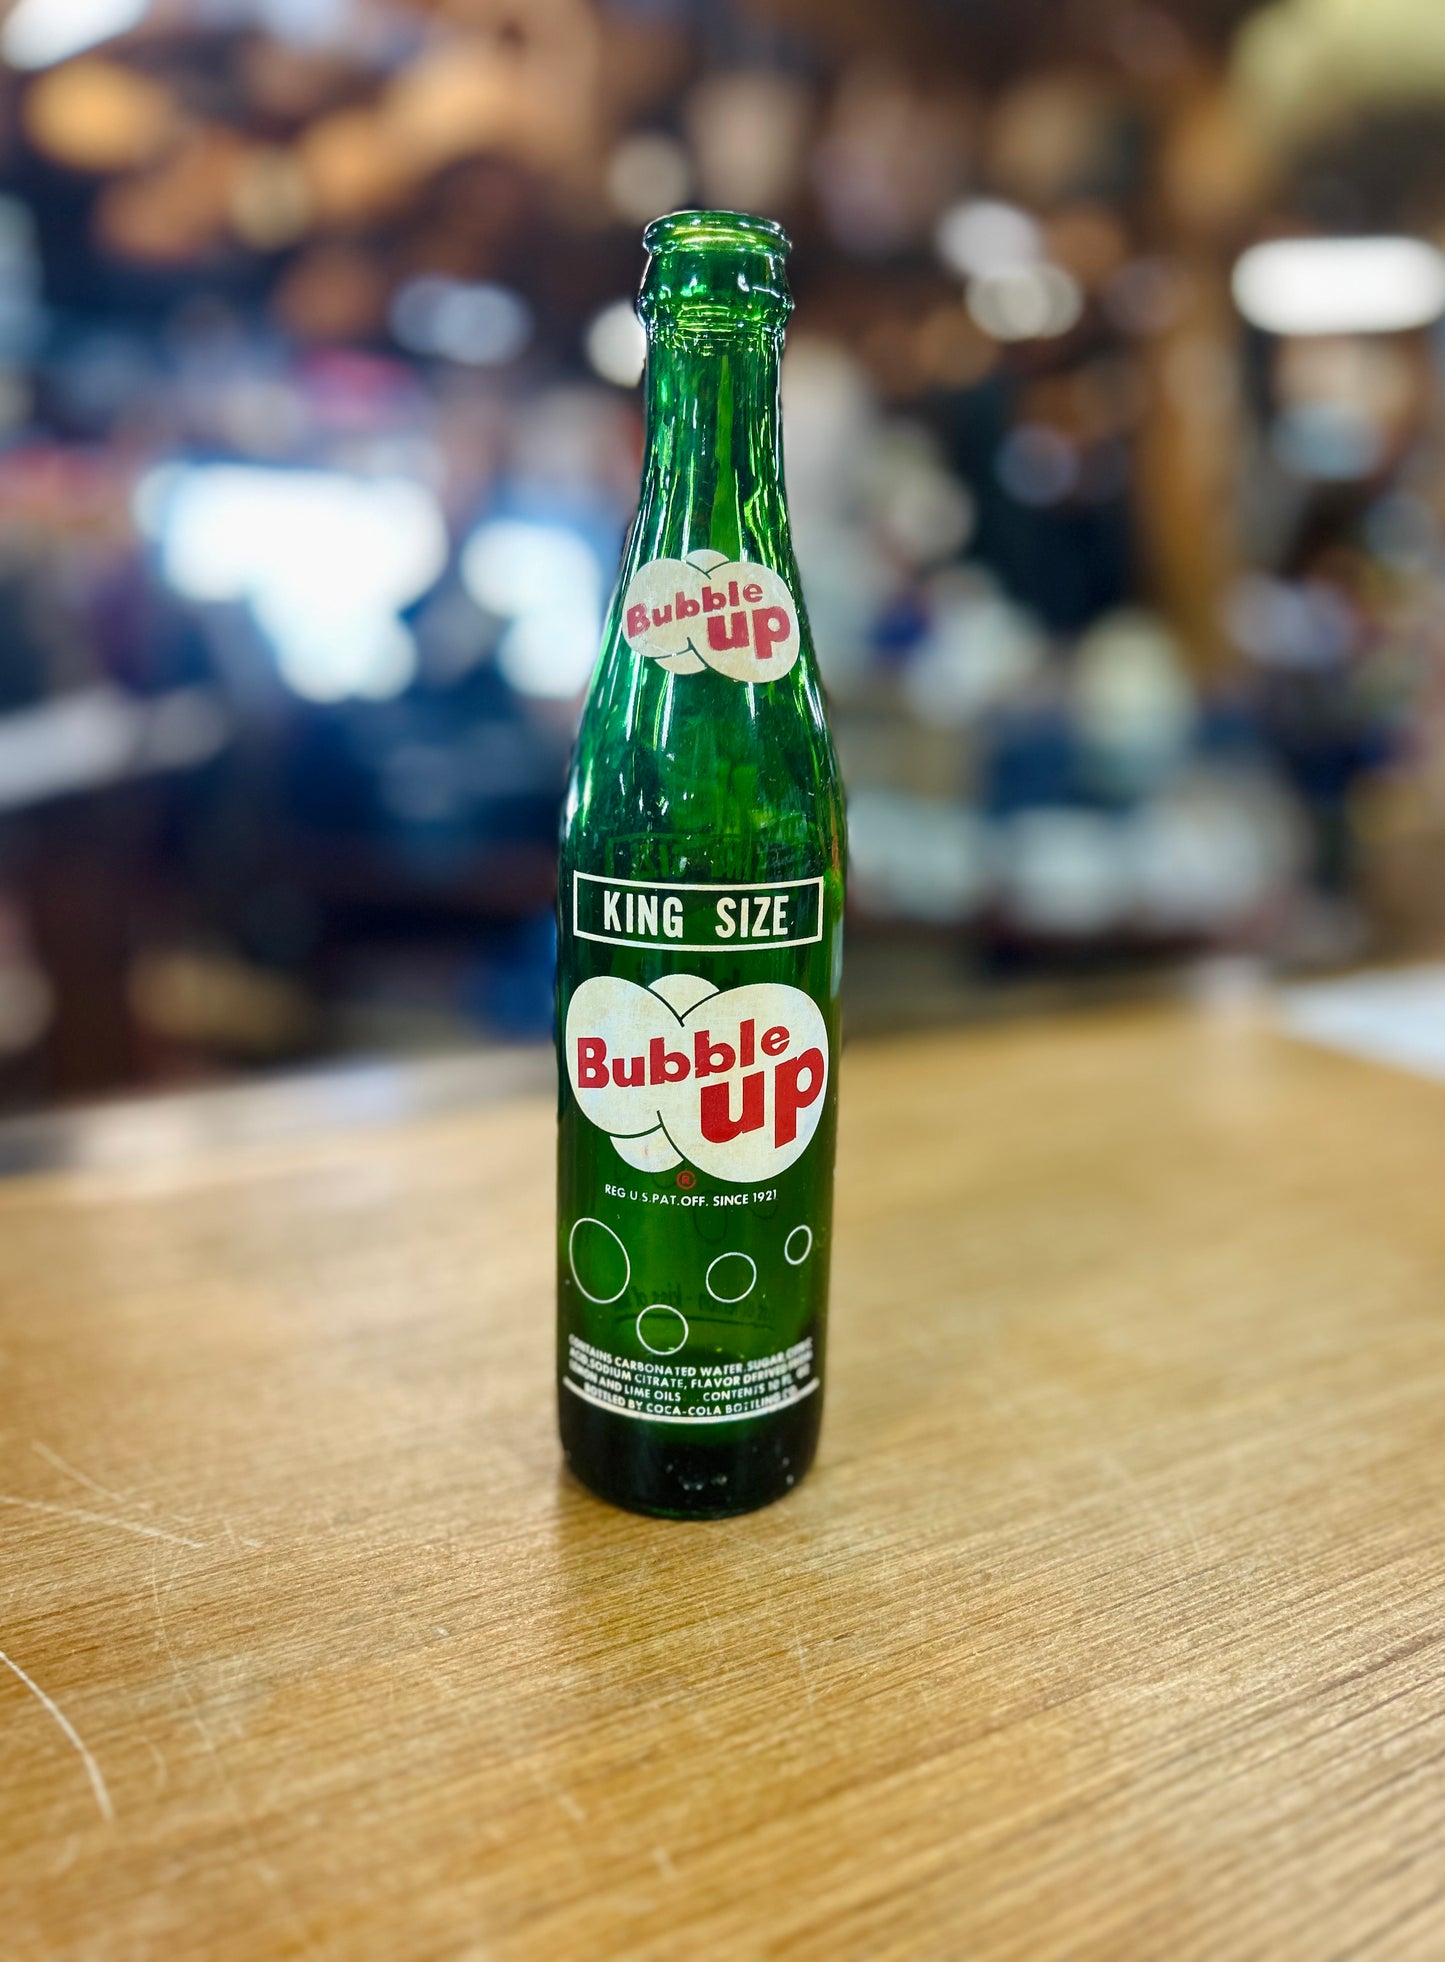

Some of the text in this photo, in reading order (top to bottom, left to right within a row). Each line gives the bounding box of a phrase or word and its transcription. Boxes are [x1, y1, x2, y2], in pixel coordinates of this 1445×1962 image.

[626, 581, 763, 639] Bubble
[706, 606, 791, 660] up
[603, 890, 790, 939] KING SIZE
[577, 1018, 790, 1089] Bubble
[700, 1047, 825, 1149] up
[713, 1193, 749, 1207] SINCE
[753, 1188, 777, 1203] 1921
[589, 1357, 632, 1382] SODIUM
[634, 1373, 688, 1390] CITRATE,
[691, 1375, 741, 1389] FLAVOR
[743, 1363, 788, 1385] DERIVED
[614, 1356, 697, 1377] CARBONATED
[583, 1381, 626, 1407] BOTTLED
[627, 1398, 643, 1411] BY
[646, 1403, 722, 1417] COCA-COLA
[725, 1391, 781, 1415] BOTTLING
[599, 1376, 623, 1393] AND
[624, 1384, 651, 1399] LIME
[702, 1382, 766, 1402] CONTENTS
